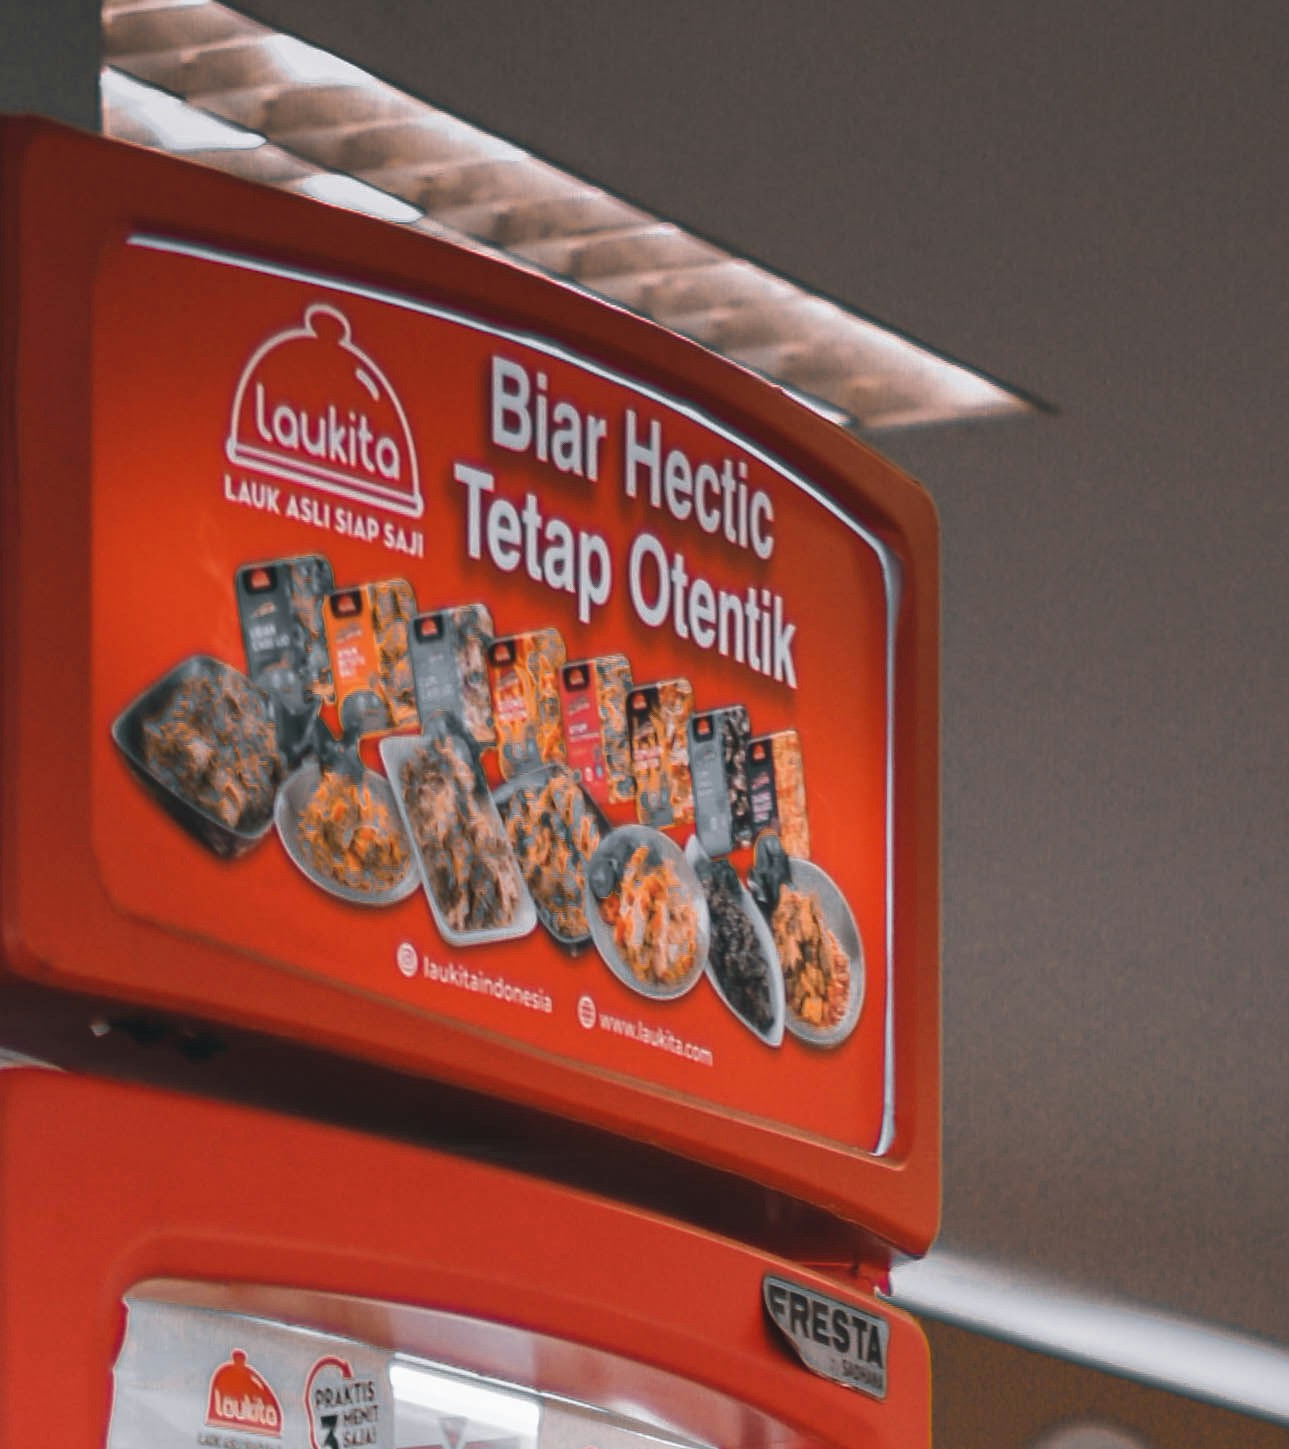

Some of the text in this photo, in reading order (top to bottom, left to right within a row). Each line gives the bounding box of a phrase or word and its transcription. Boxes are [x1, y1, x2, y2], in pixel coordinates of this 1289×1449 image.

[491, 355, 776, 560] Biar Hectic
[224, 474, 424, 558] LAUK ASLI SIAP SAJI
[454, 463, 798, 689] Tetap Otentik
[423, 956, 553, 1013] laukitaindonesia
[598, 1011, 713, 1067] www.laukita.com
[768, 1284, 884, 1370] FRESTA
[315, 1380, 376, 1408] PRAKTIS
